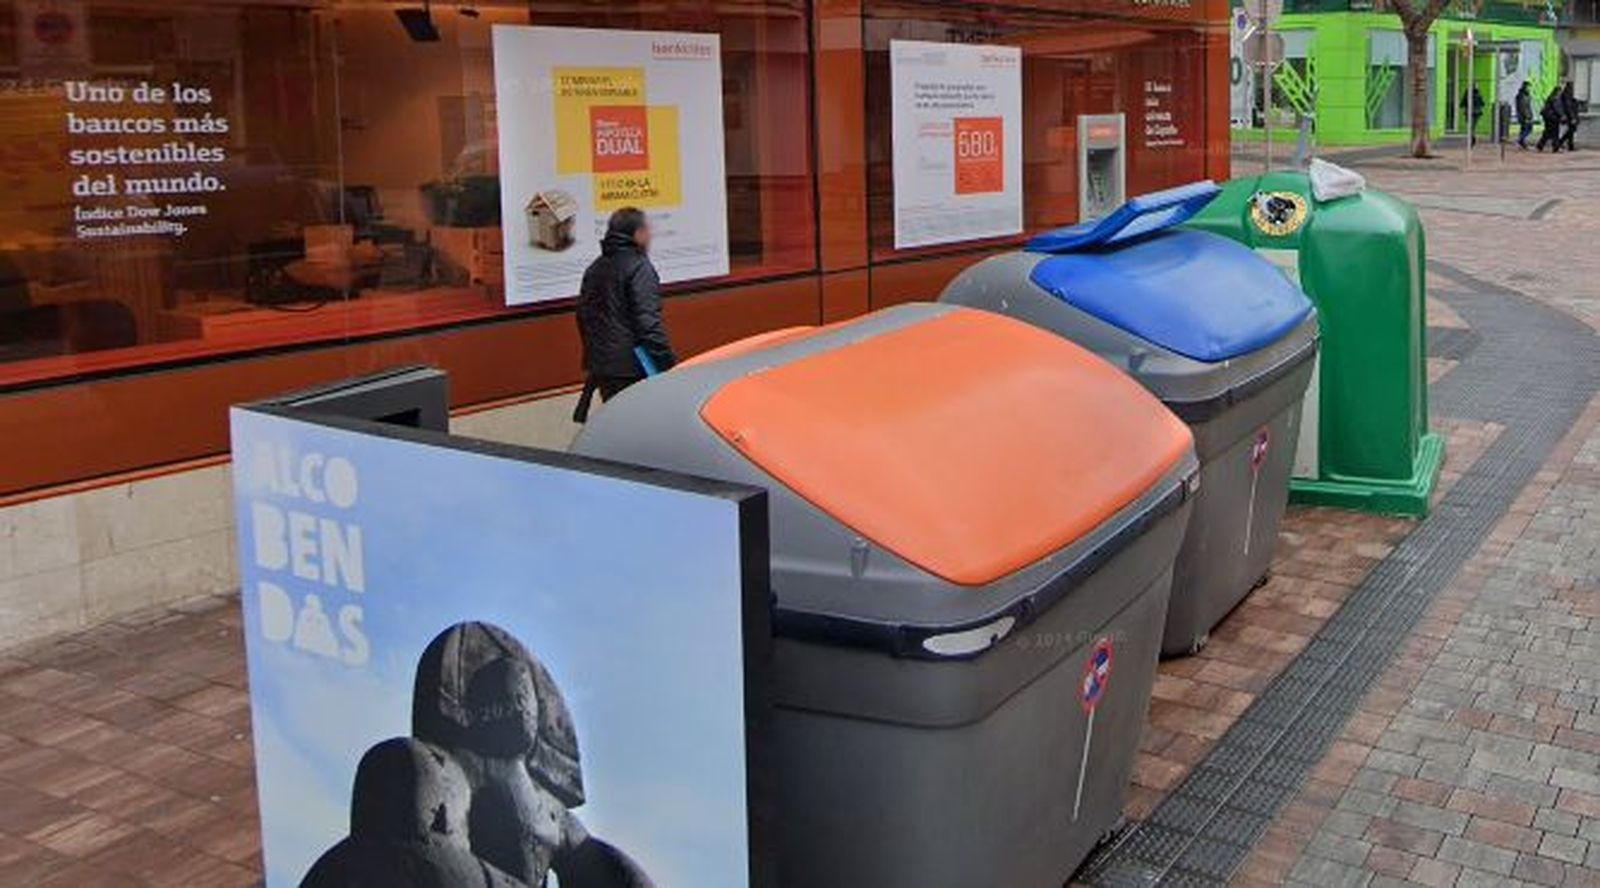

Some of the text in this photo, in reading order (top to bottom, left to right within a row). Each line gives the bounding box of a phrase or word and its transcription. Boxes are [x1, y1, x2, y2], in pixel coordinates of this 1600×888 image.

[64, 80, 123, 103] Uno
[132, 81, 165, 103] de
[172, 82, 212, 104] los
[67, 112, 229, 133] bancos más
[69, 142, 225, 165] sostenibles
[597, 138, 644, 155] DUAL
[72, 172, 226, 196] del mundo.
[126, 206, 160, 218] Dow
[250, 442, 358, 509] ALCO
[252, 501, 364, 594] BEN
[257, 580, 370, 667] DAS
